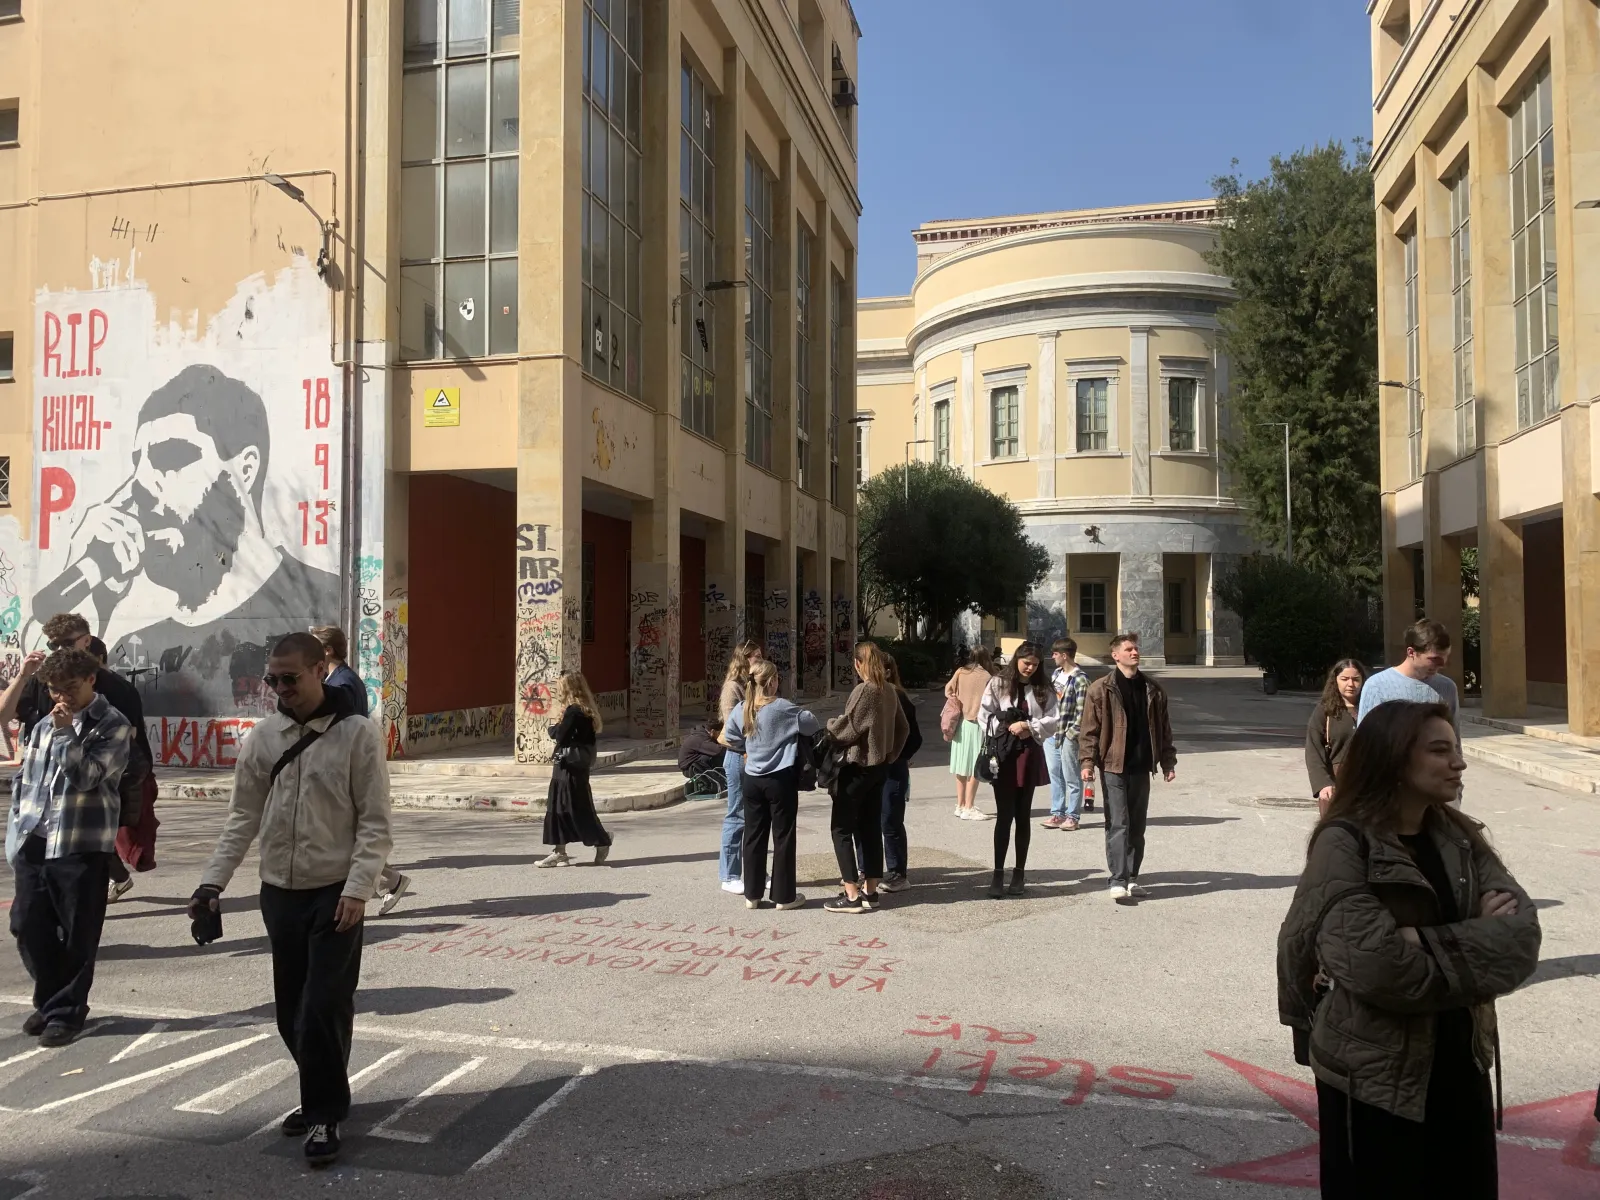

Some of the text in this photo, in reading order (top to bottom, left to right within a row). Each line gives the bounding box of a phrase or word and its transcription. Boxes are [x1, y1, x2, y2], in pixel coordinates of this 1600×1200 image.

[302, 377, 331, 430] 18
[314, 443, 329, 490] 9
[38, 466, 76, 550] P
[298, 500, 329, 546] 13
[742, 965, 887, 993] ΚΑΜΙΑ
